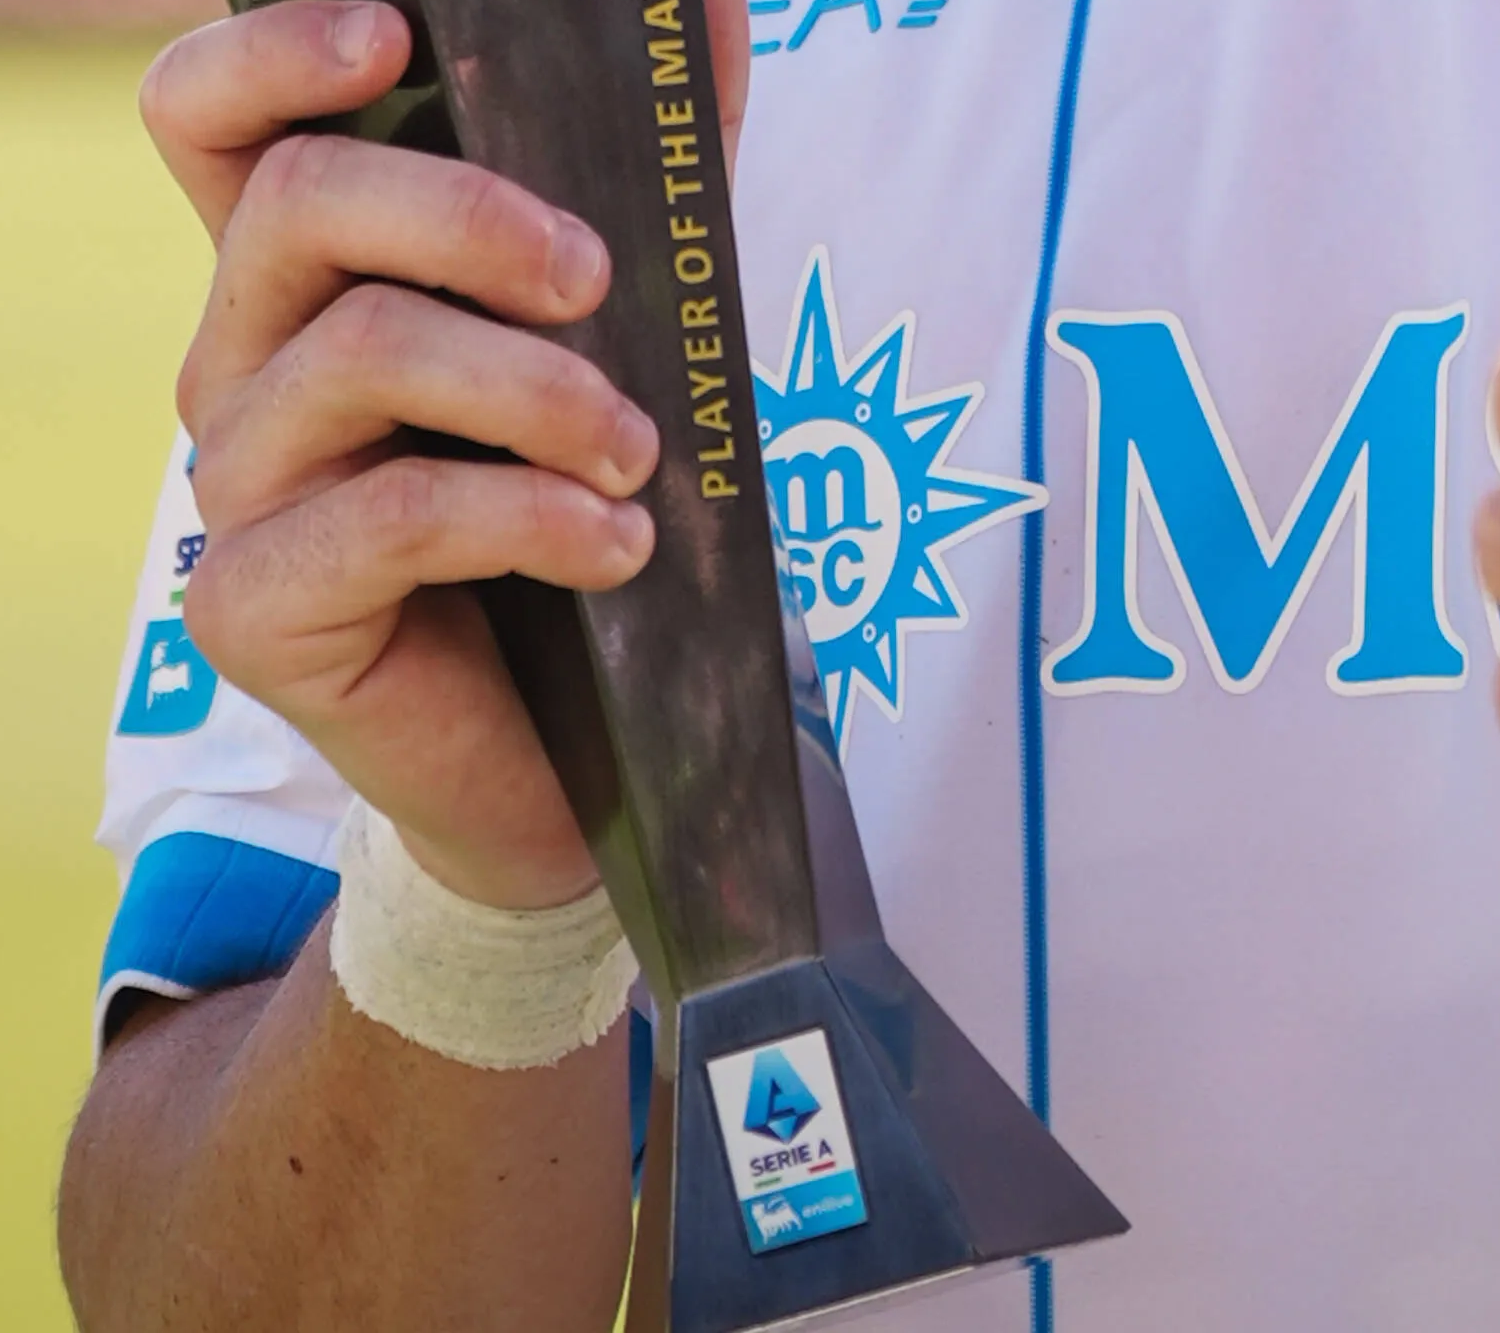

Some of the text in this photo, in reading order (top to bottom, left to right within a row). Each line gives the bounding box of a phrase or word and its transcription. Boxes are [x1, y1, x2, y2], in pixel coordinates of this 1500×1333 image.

[654, 98, 704, 205] THE
[669, 215, 714, 284] OF
[680, 295, 740, 499] PLAYER
[750, 1138, 833, 1176] SERIE A
